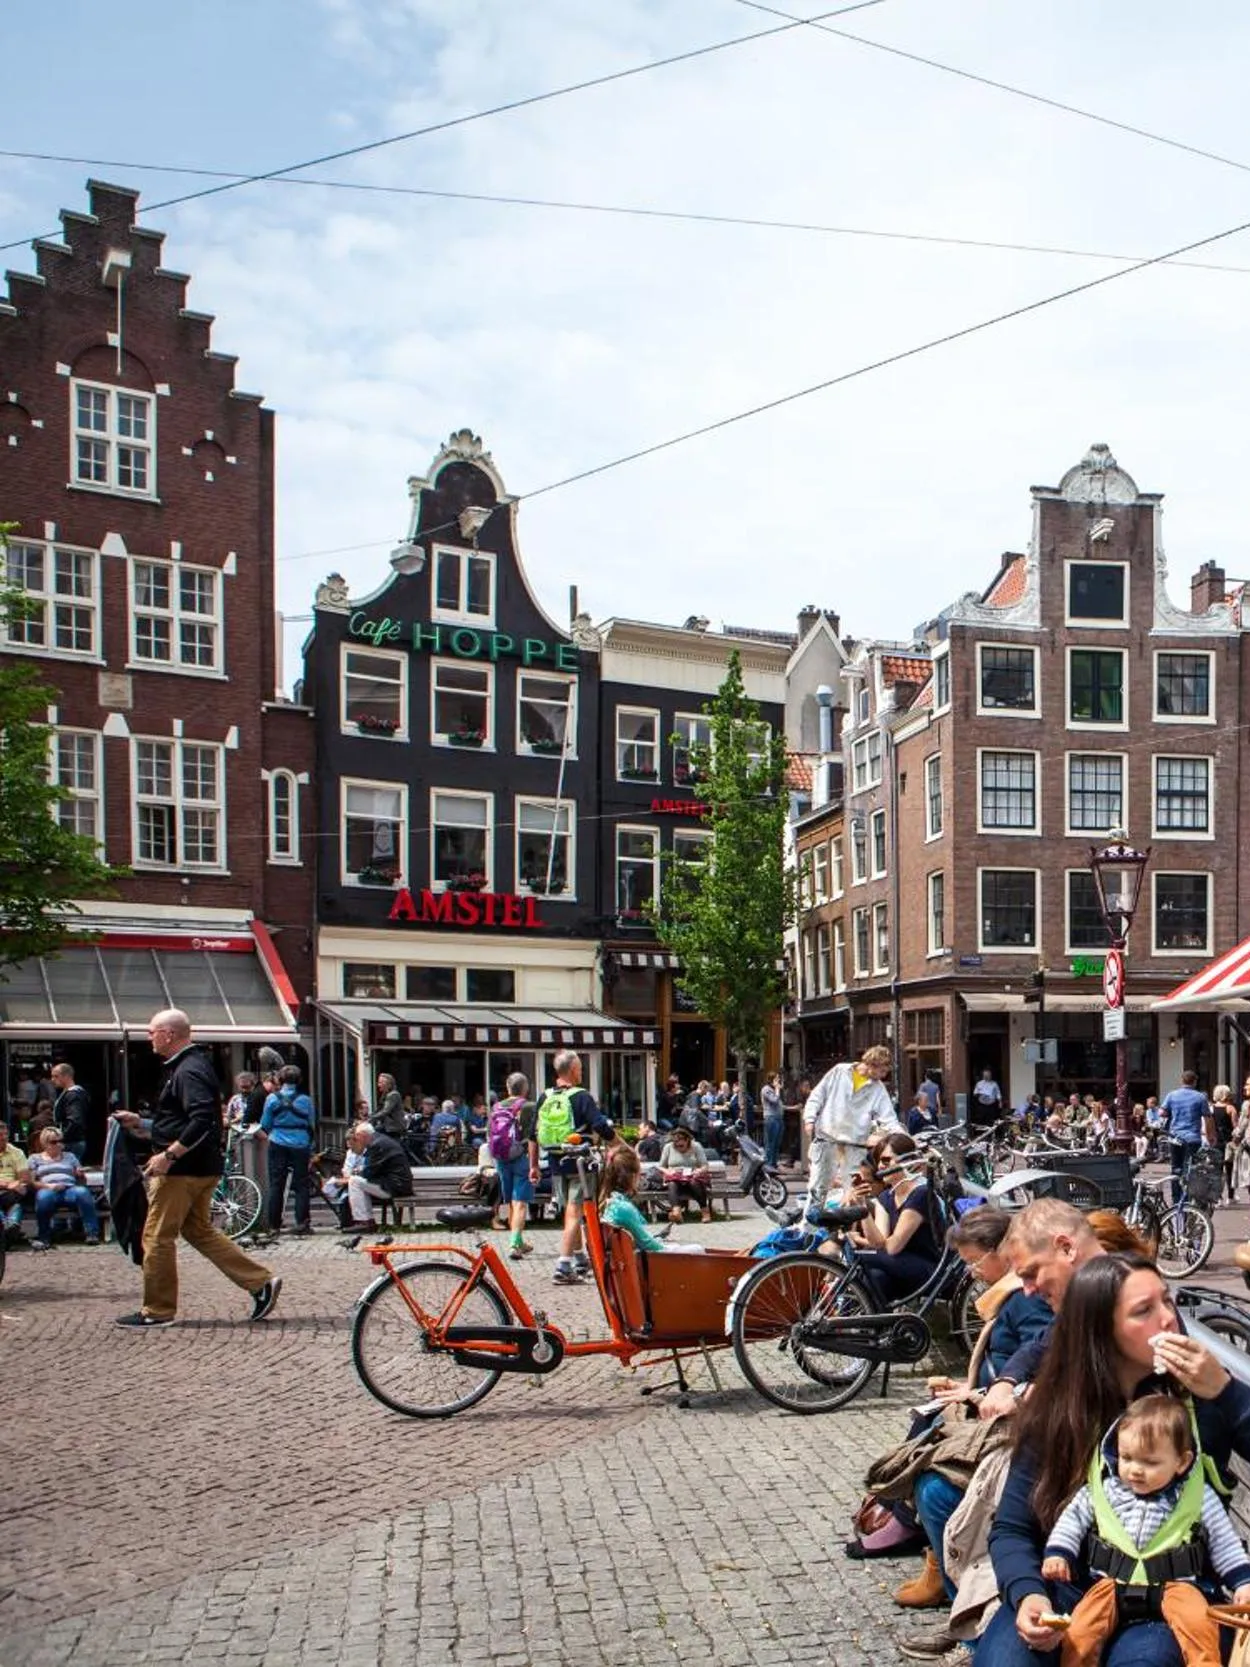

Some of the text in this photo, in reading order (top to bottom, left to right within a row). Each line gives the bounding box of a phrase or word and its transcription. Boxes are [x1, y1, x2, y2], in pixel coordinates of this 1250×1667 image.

[350, 611, 580, 671] Café HOPPE
[388, 887, 548, 928] AMSTEL
